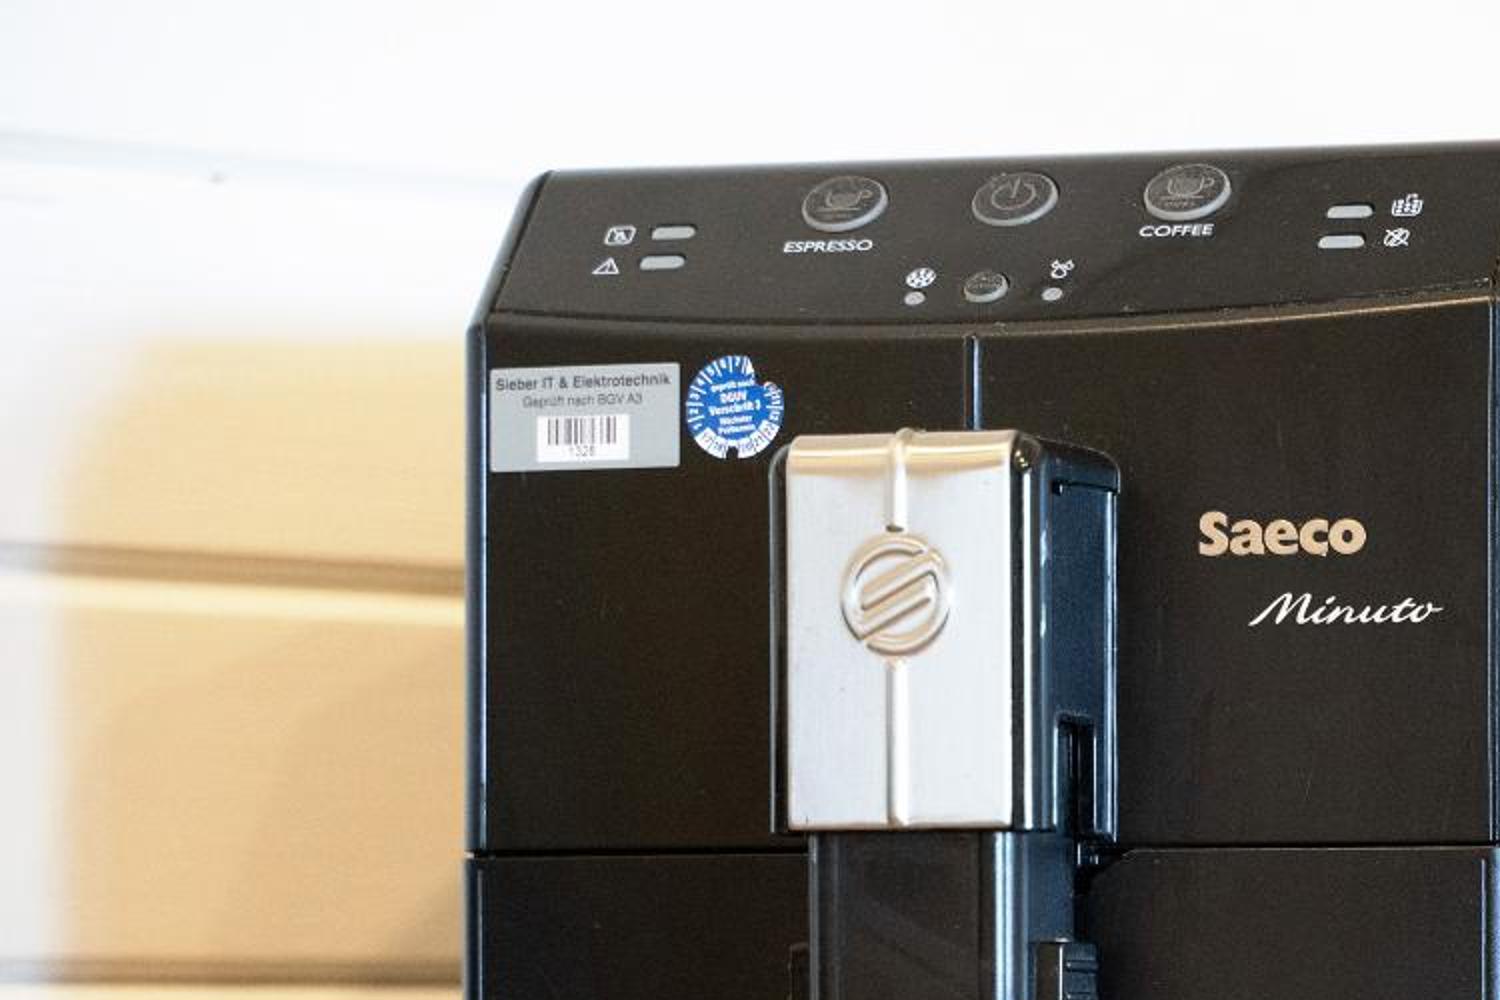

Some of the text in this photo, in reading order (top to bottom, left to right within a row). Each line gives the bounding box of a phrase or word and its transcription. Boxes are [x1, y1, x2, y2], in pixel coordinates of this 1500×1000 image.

[1139, 223, 1214, 237] COFFEE
[783, 239, 873, 253] ESPRESSO
[495, 372, 671, 391] Sieber IT & Elektrotechnik
[522, 393, 643, 409] Geprüft nach BGV A3
[1199, 510, 1367, 557] Saeco
[1247, 591, 1444, 627] Minuto
